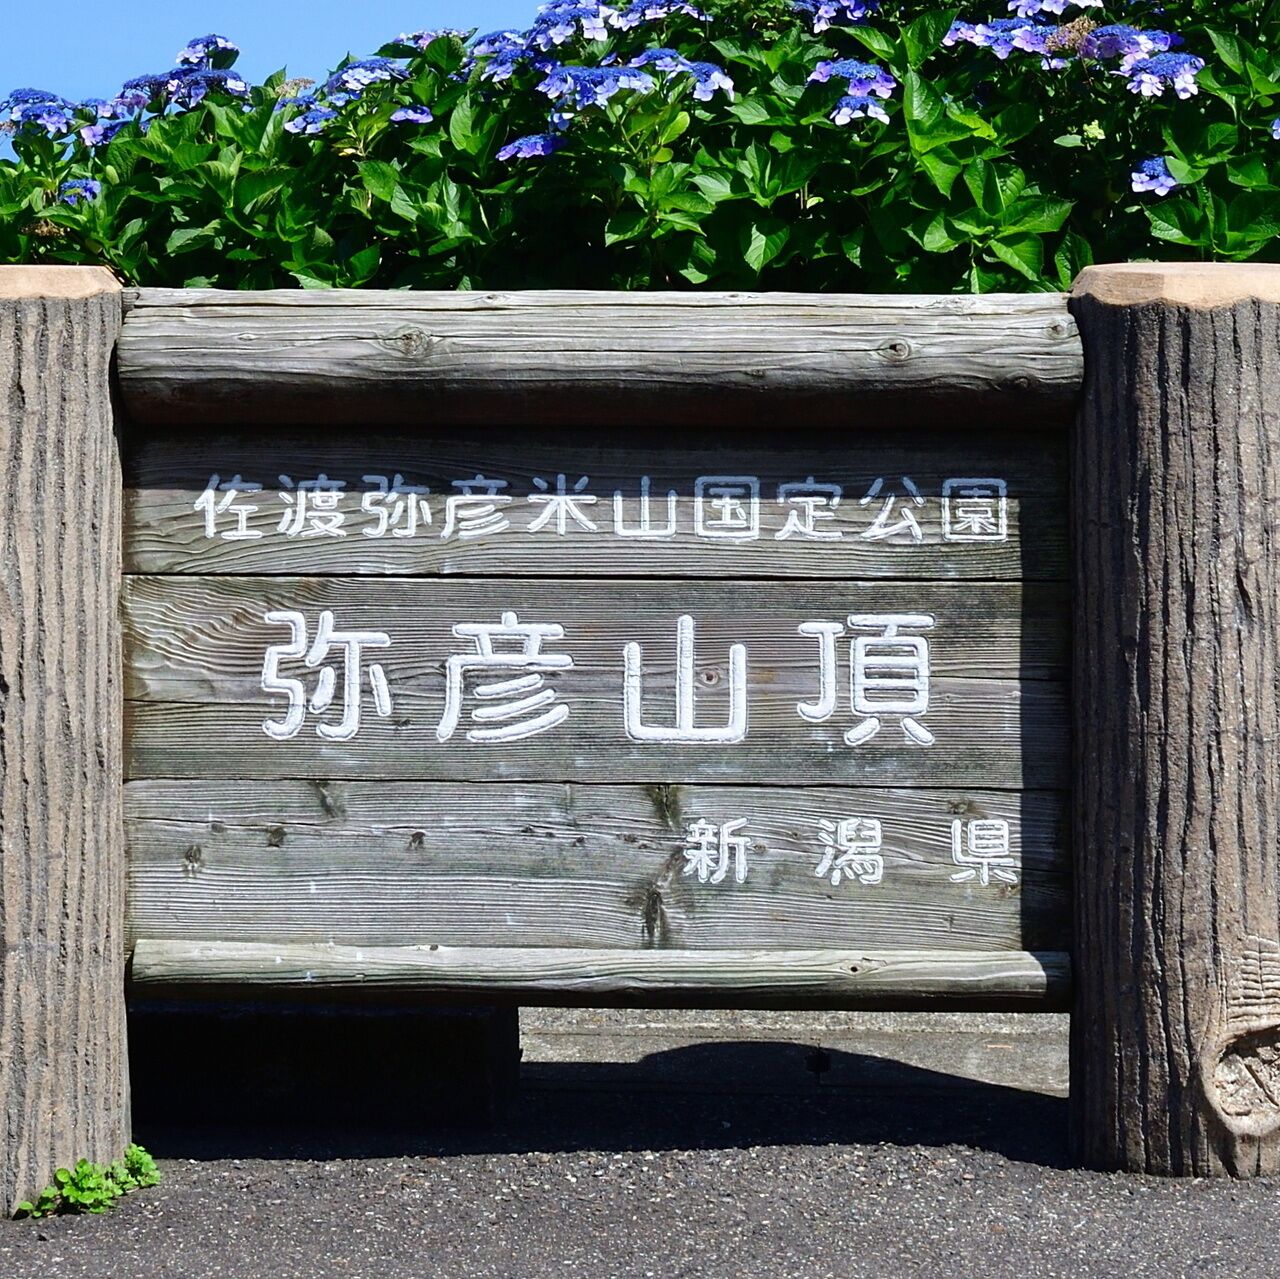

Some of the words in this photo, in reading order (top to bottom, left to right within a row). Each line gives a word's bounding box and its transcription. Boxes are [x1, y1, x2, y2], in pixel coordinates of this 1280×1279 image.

[194, 473, 1010, 543] 佐渡弥彦米山国定公園
[261, 610, 936, 747] 弥彦山頂
[682, 817, 1019, 886] 新潟県
